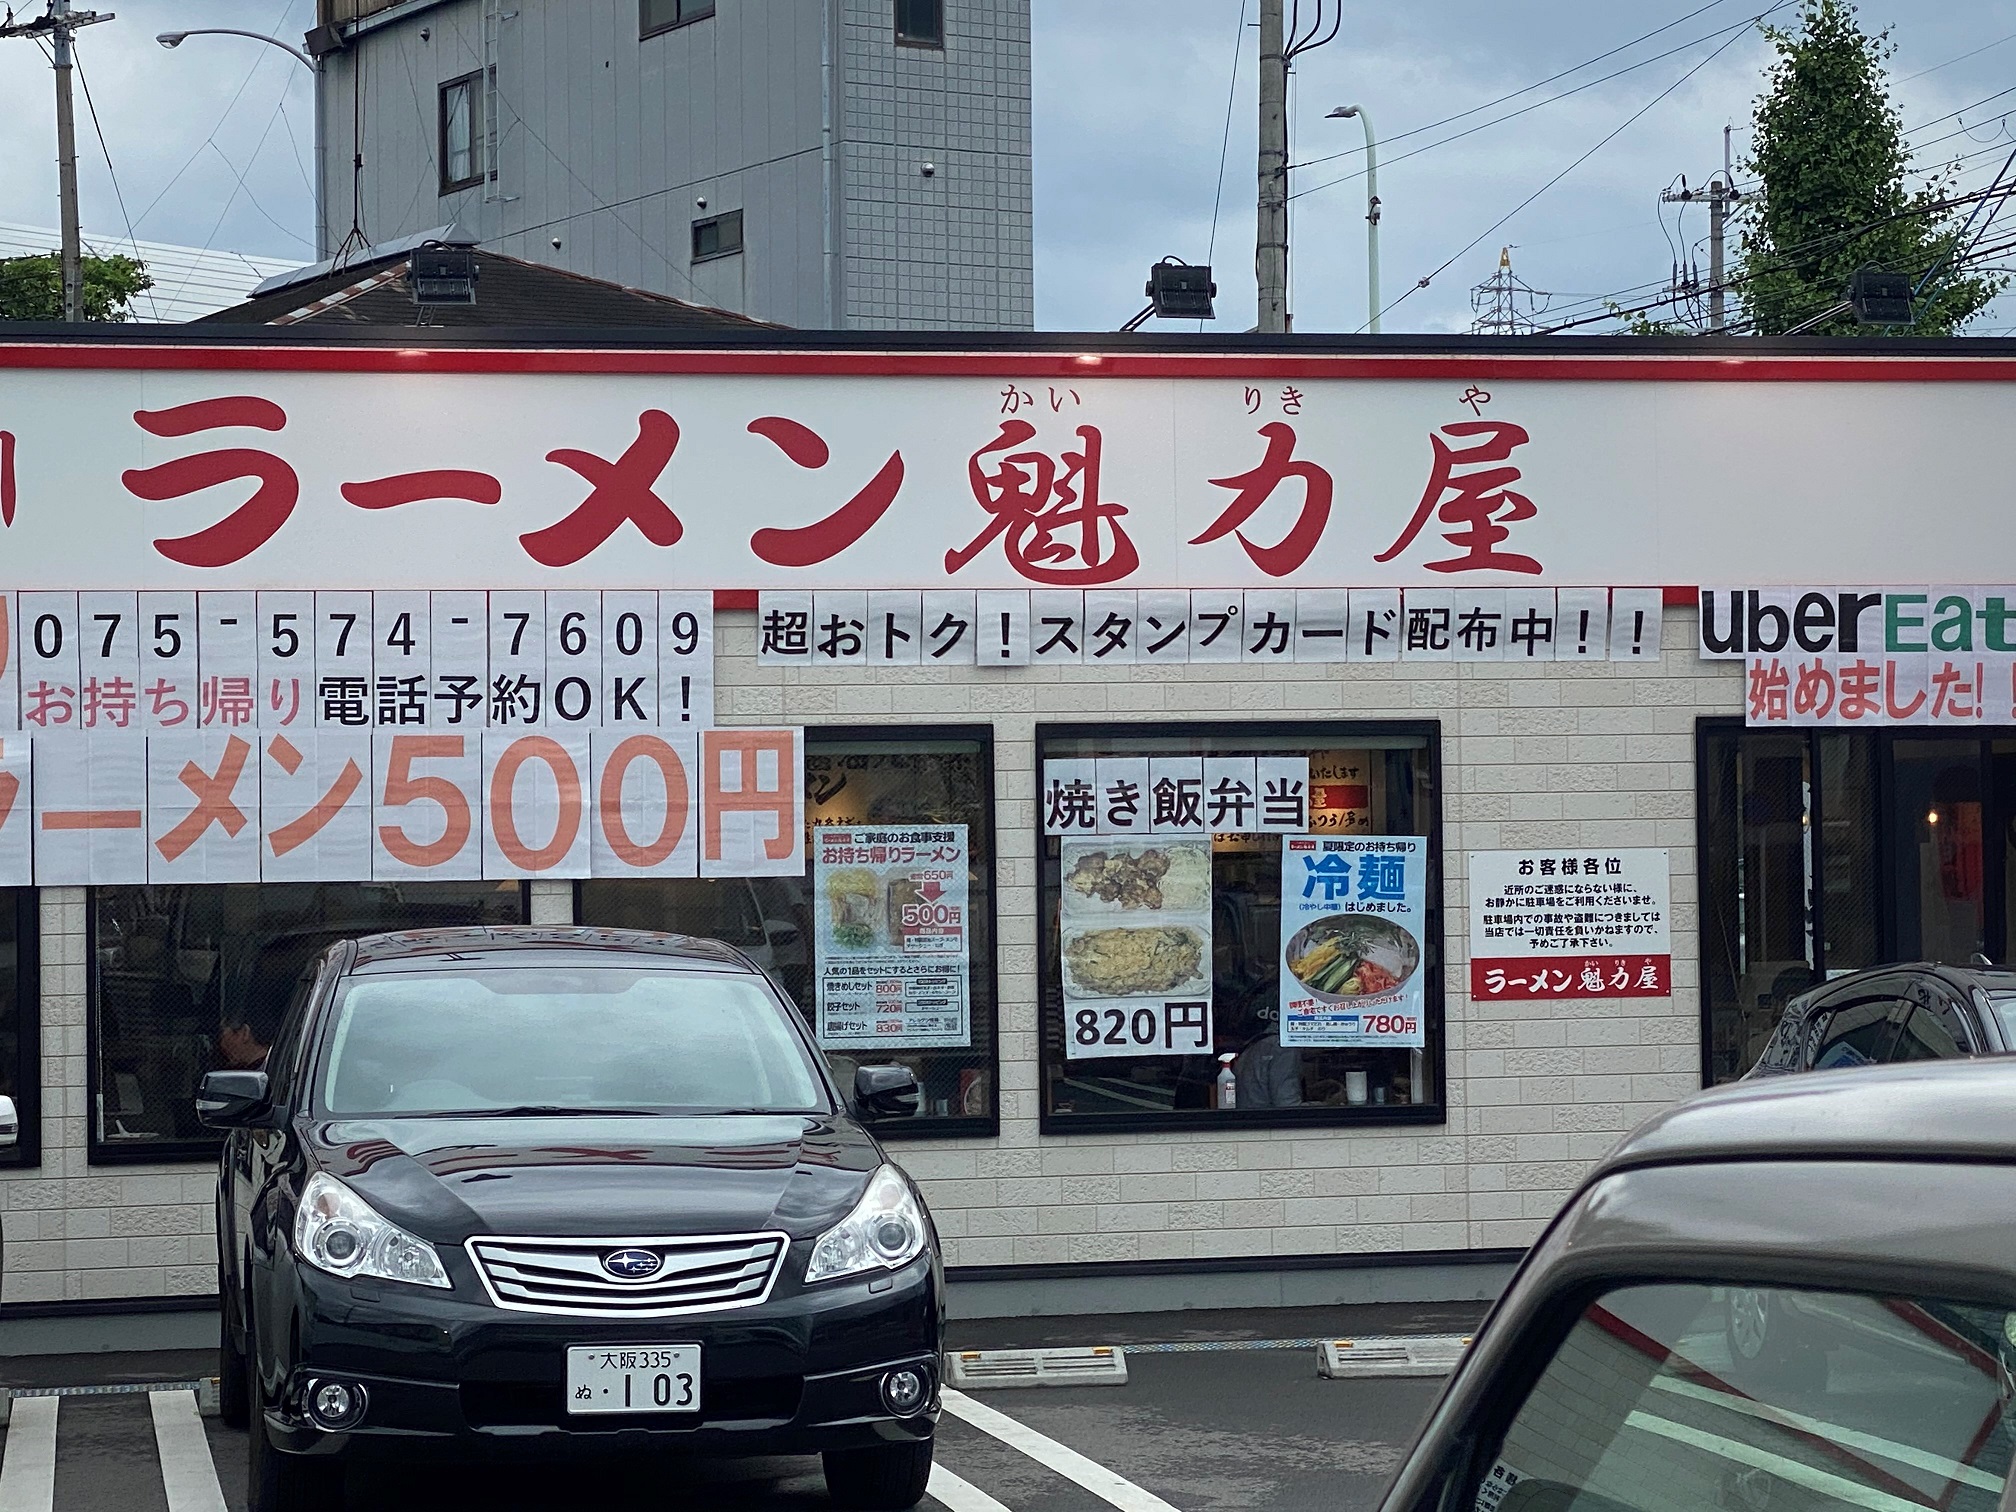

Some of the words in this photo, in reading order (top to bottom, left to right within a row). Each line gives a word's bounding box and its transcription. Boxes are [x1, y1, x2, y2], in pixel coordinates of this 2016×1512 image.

[1000, 384, 1082, 415] かい
[1243, 384, 1306, 416] りき
[1460, 384, 1492, 415] や
[32, 611, 699, 659] 075-574-7609
[0, 730, 795, 872] ーメン500円
[1046, 776, 1306, 830] 焼き飯弁当
[822, 845, 961, 865] お持ち帰りラーメン
[1518, 857, 1622, 876] お客様各位
[1302, 853, 1406, 901] 冷麺
[903, 904, 961, 925] 500円
[1345, 902, 1412, 913] はじめました。
[1074, 1001, 1209, 1048] 820円
[1363, 1014, 1417, 1034] 780円
[575, 1384, 592, 1400] ぬ
